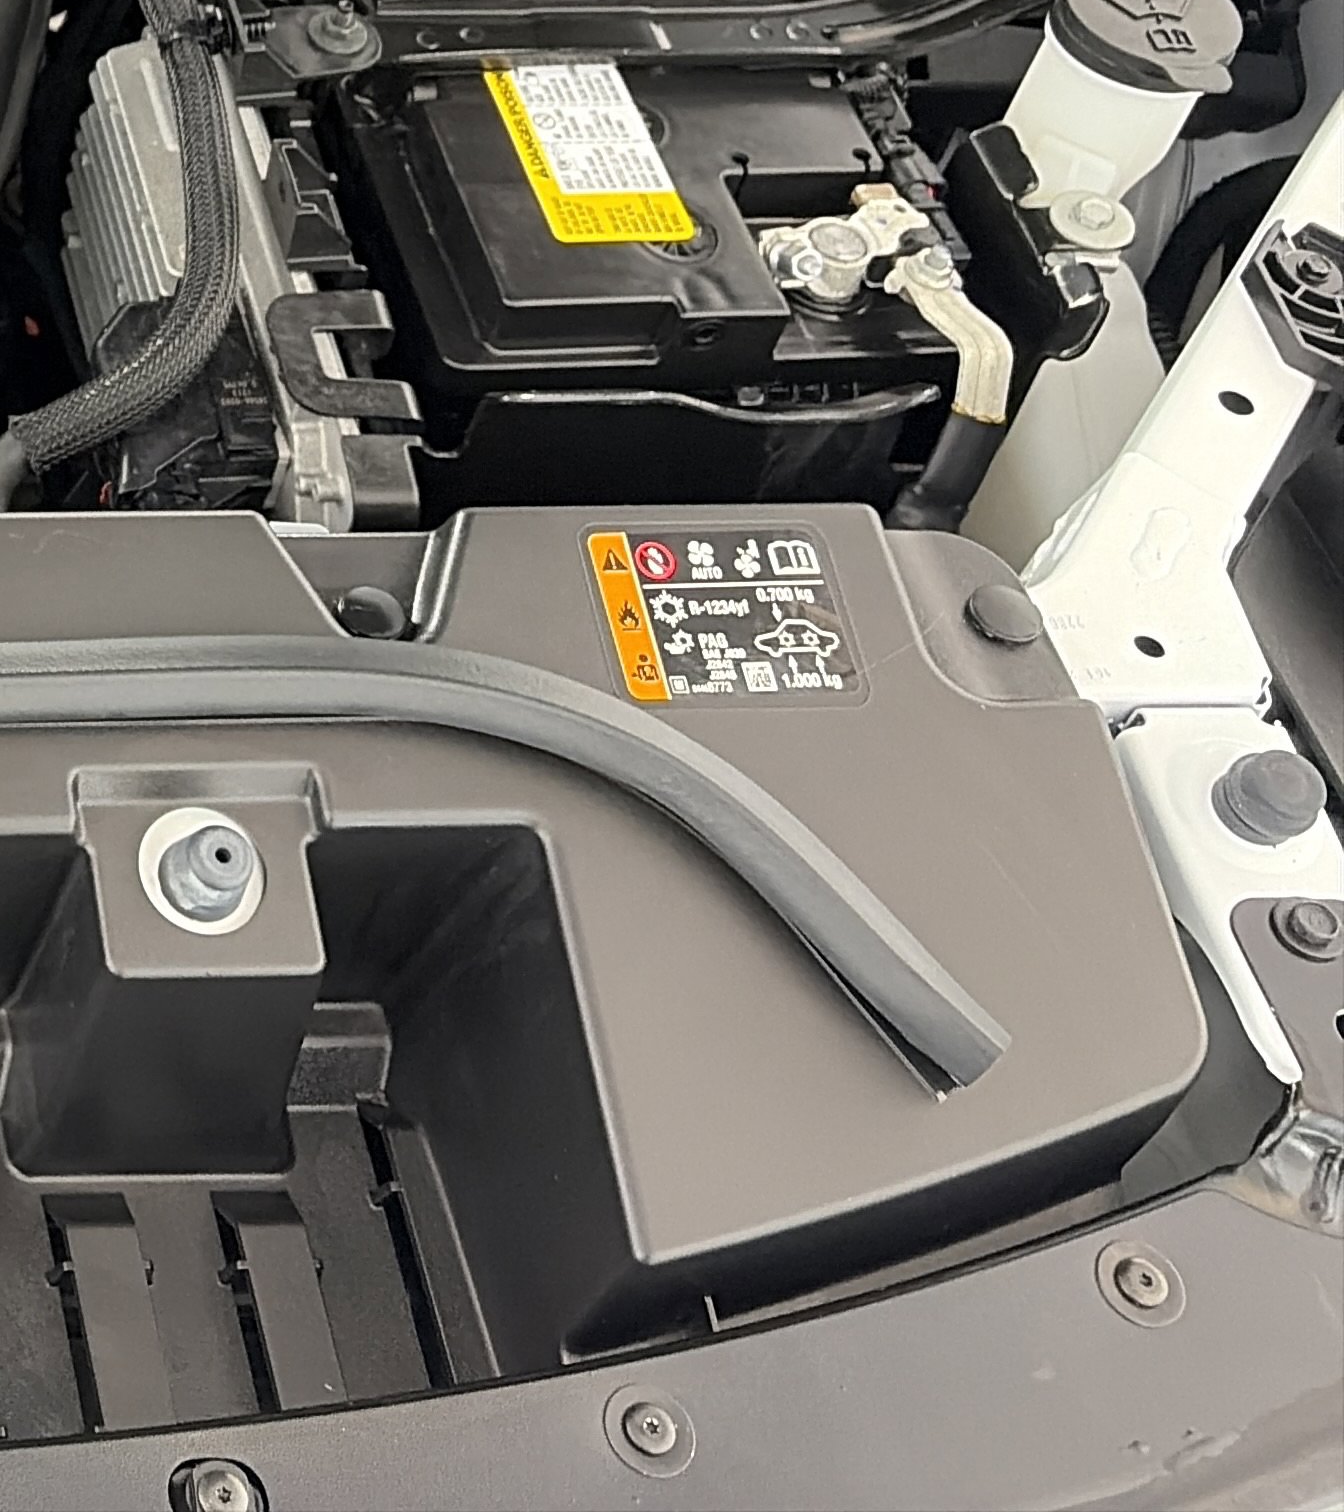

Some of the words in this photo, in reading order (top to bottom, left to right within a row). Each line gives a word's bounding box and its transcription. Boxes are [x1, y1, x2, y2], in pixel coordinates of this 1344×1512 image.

[692, 565, 723, 579] AUTO
[755, 587, 794, 602] 0.700
[794, 587, 815, 604] kg
[688, 598, 750, 617] R-1234yf
[698, 632, 729, 649] PAG
[782, 672, 823, 689] 1.000
[824, 672, 843, 690] kg
